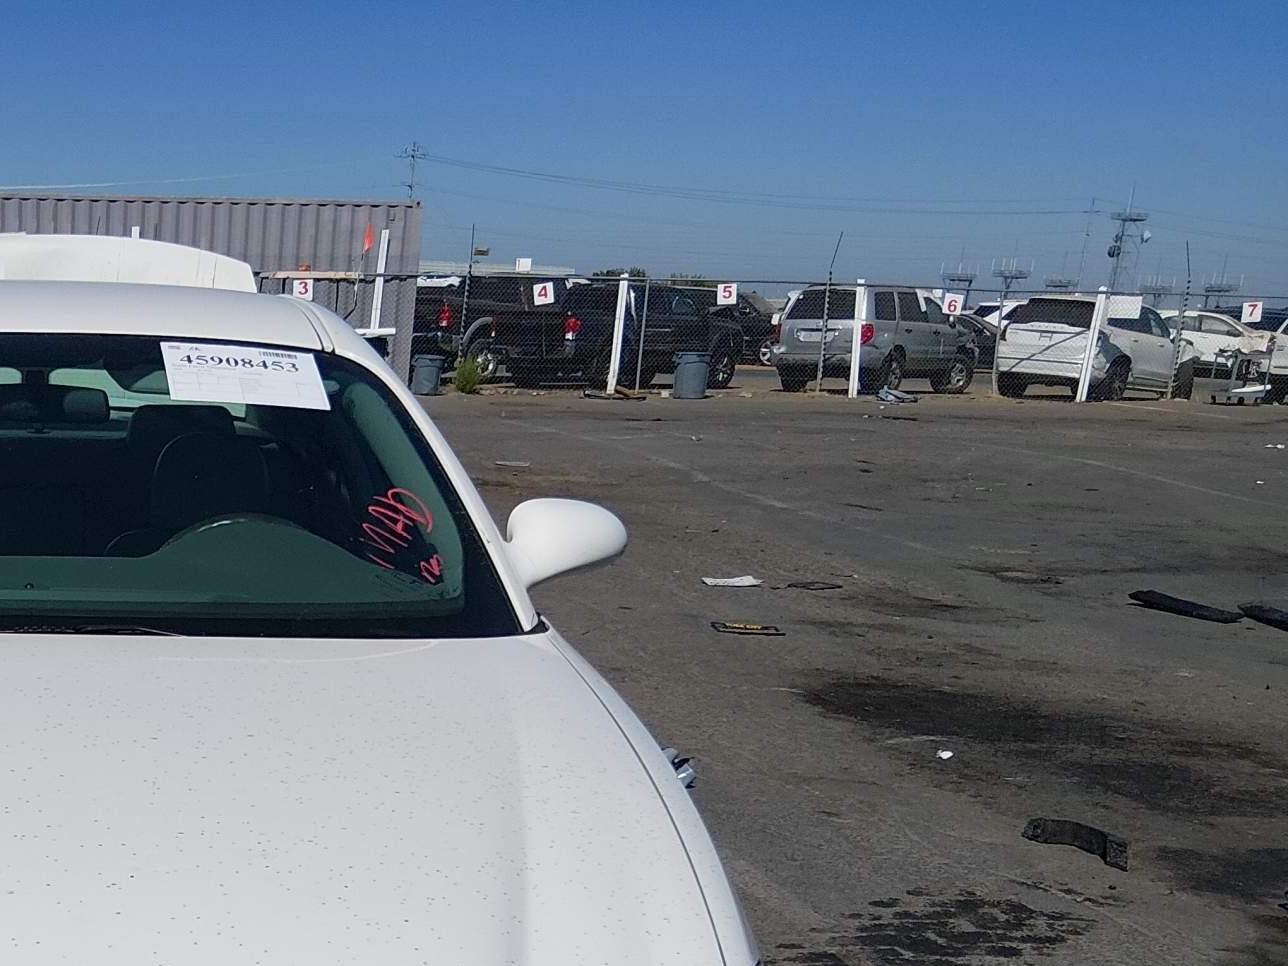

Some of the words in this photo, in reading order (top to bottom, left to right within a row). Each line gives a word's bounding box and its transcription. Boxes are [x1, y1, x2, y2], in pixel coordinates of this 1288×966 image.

[298, 281, 308, 295] 3
[537, 285, 548, 299] 4
[722, 285, 733, 299] 5
[947, 299, 959, 313] 6
[1248, 303, 1258, 317] 7
[179, 354, 300, 373] 45908453
